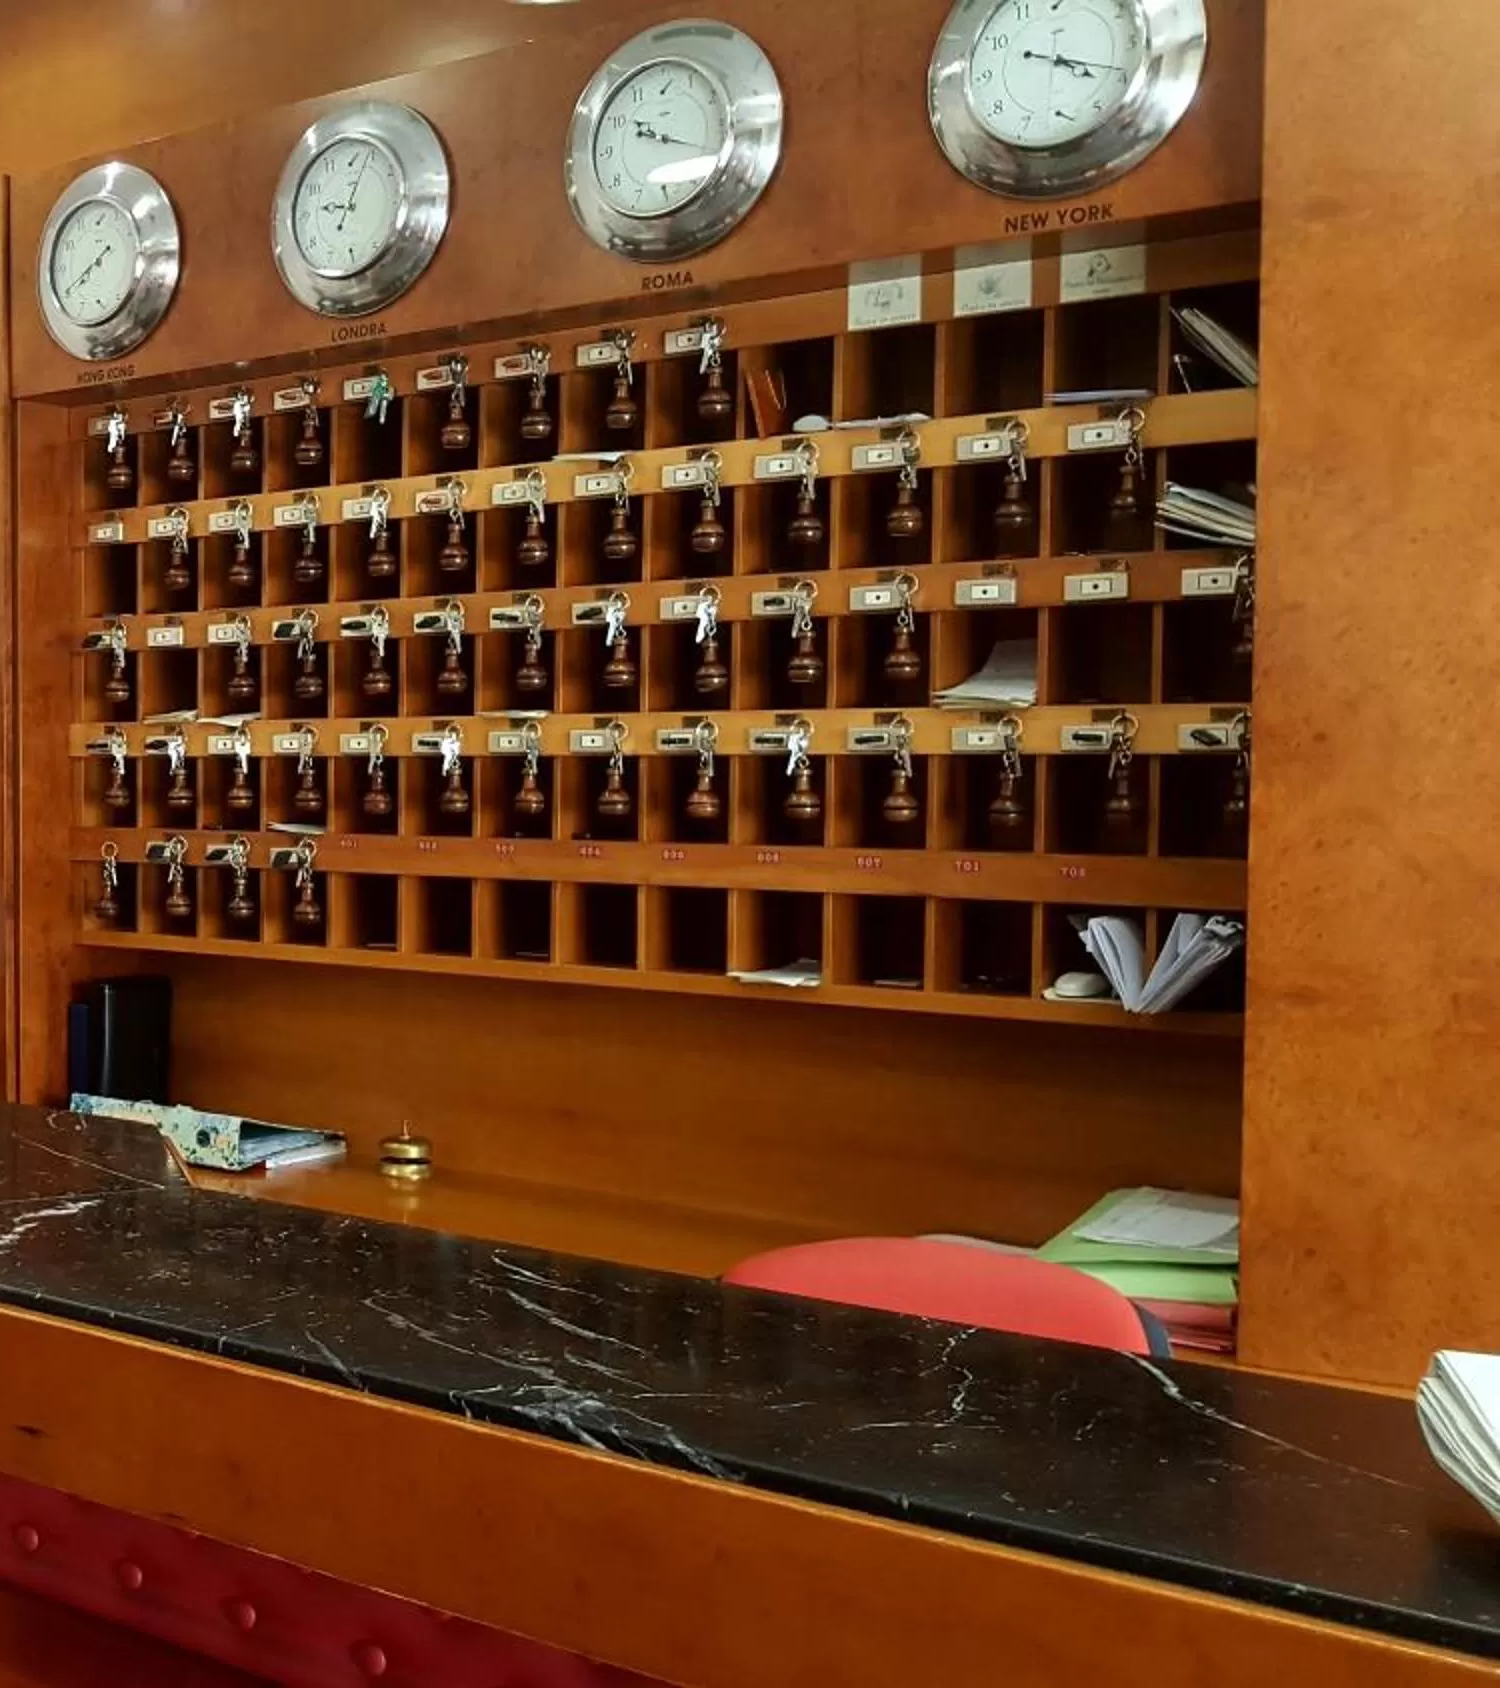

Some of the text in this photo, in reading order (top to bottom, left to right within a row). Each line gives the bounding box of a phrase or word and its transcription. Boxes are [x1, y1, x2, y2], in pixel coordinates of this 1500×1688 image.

[991, 34, 1009, 50] 10
[980, 69, 993, 84] 9
[632, 87, 644, 103] 11
[992, 100, 1004, 116] 8
[1004, 203, 1114, 234] NEW YORK
[642, 271, 693, 291] ROMA
[331, 322, 388, 342] LONDRA
